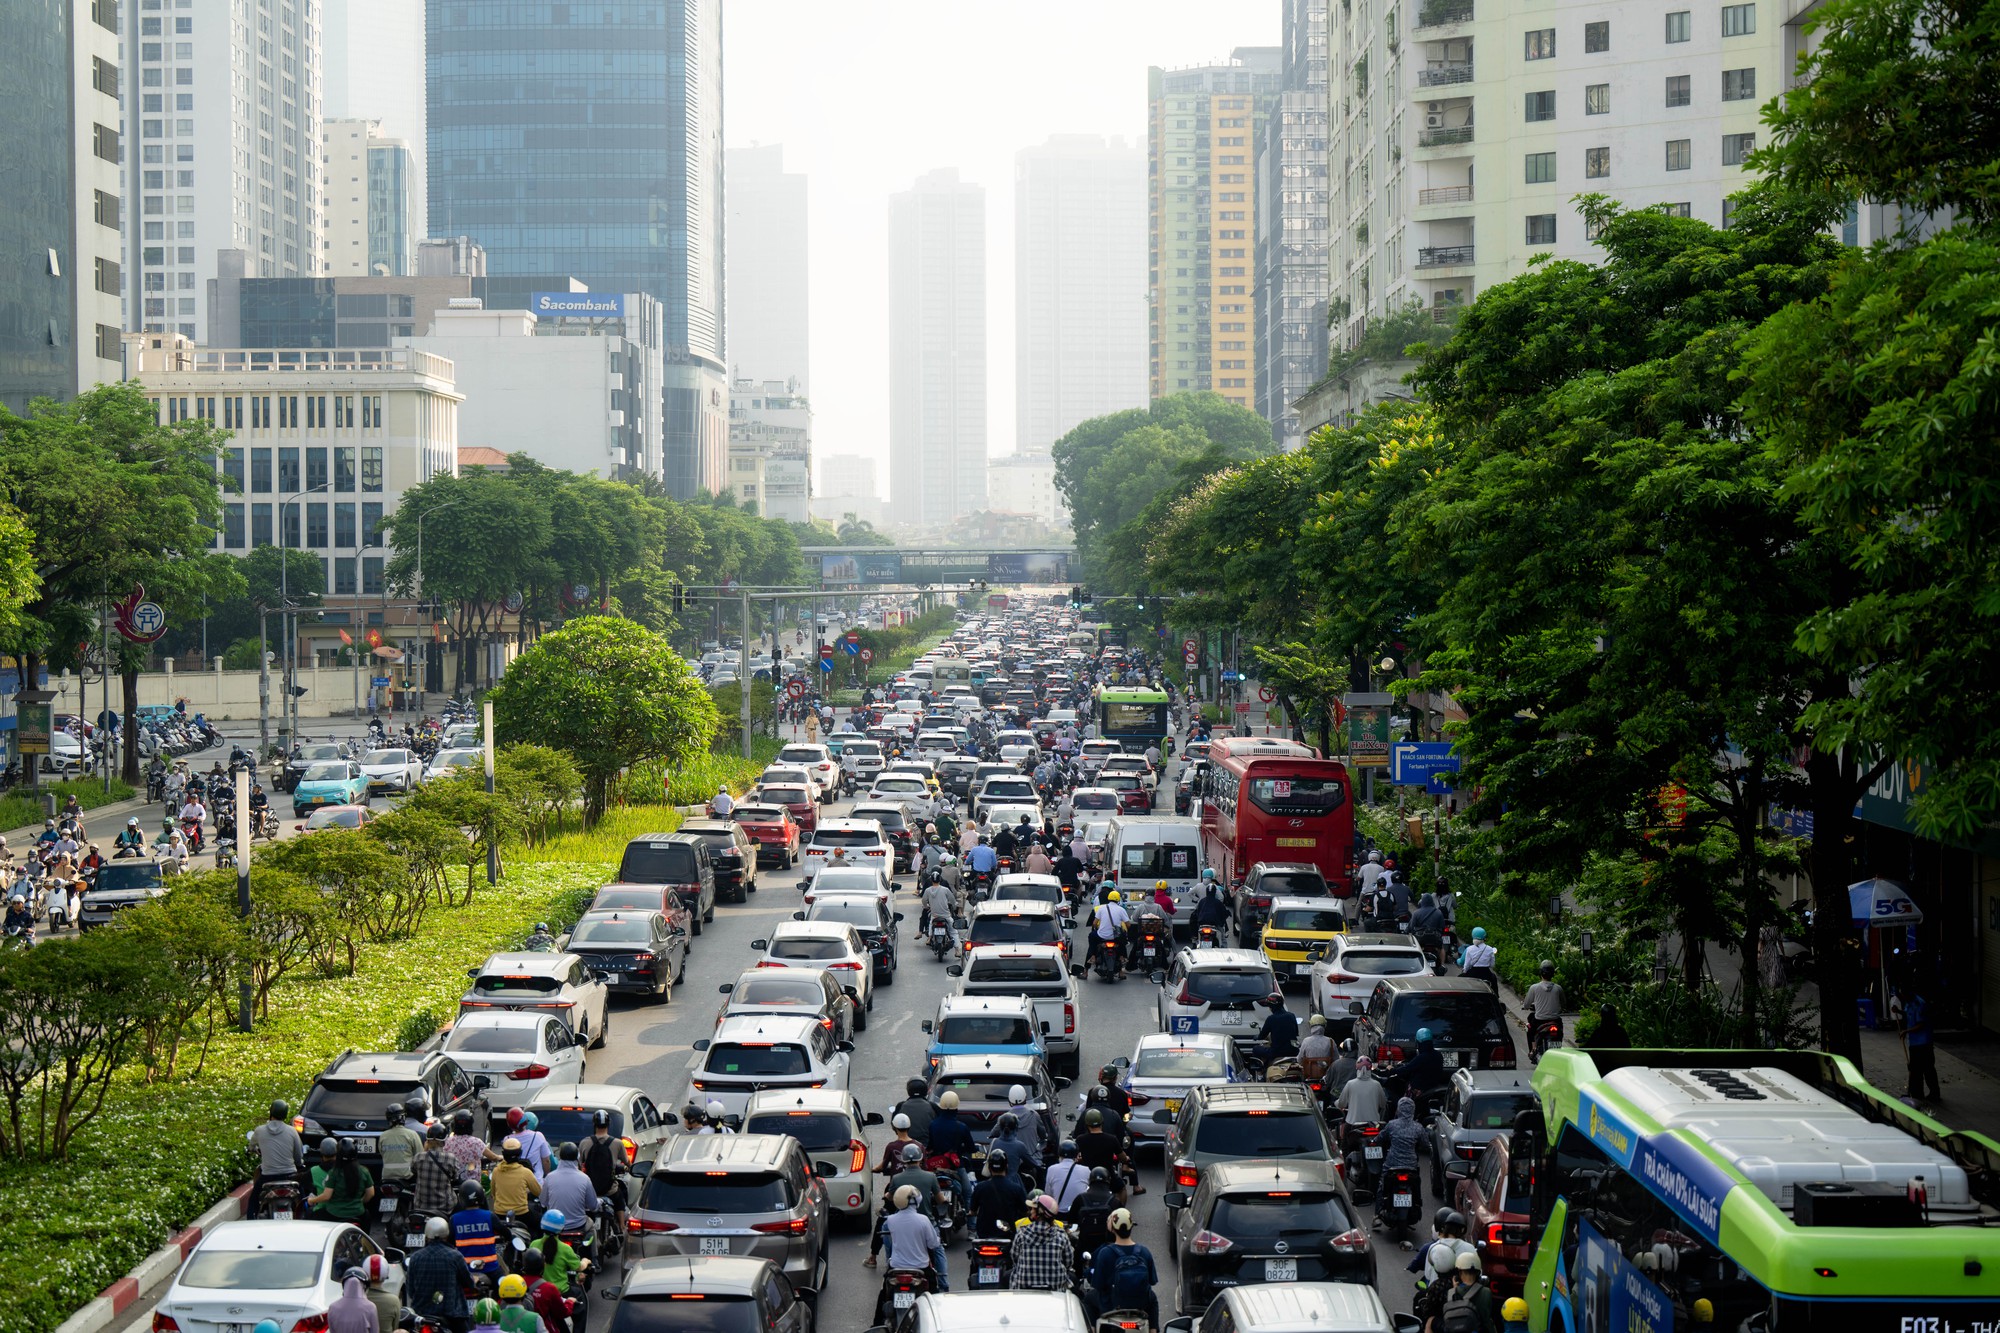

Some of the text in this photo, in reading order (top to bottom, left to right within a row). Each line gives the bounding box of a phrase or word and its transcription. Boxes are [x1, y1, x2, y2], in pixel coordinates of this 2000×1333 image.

[539, 296, 618, 311] Sacombank
[1875, 898, 1912, 914] 5G
[1178, 1017, 1191, 1031] G7
[1675, 1172, 1687, 1205] 0%
[456, 1222, 490, 1233] DELTA
[706, 1238, 722, 1248] 51H
[1272, 1259, 1288, 1269] 30F
[1266, 1269, 1295, 1280] 082.27
